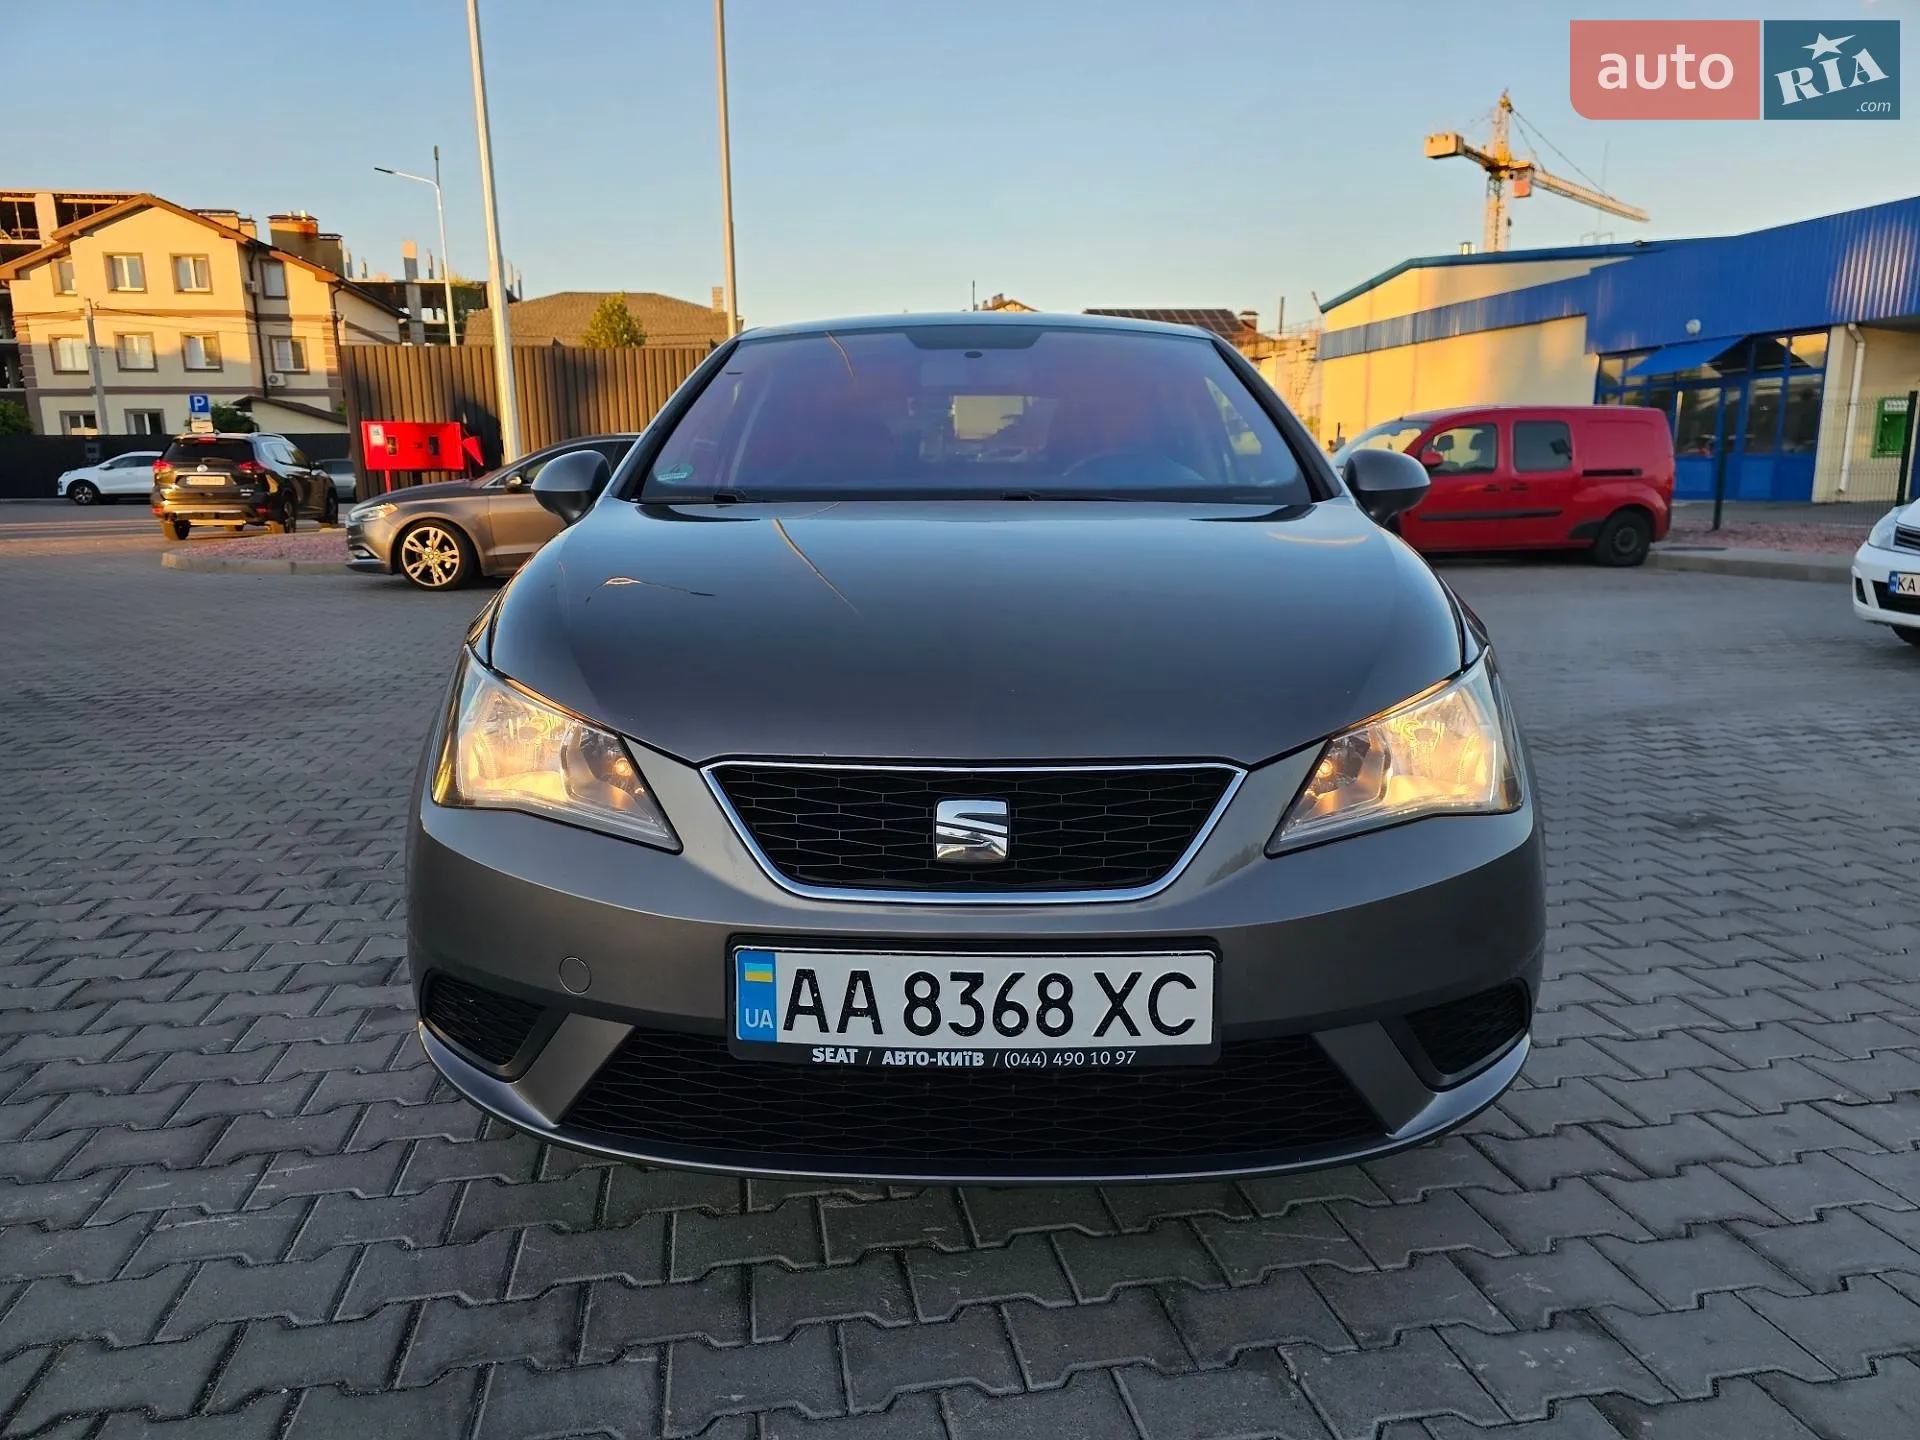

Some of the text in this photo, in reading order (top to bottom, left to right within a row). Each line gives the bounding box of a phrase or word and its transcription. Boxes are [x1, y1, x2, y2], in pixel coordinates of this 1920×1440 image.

[193, 396, 205, 411] P
[1897, 576, 1916, 592] KA
[783, 968, 1197, 1038] AA 8368 XC
[745, 1008, 774, 1029] UA
[812, 1047, 859, 1064] SEAT
[1003, 1051, 1048, 1068] (044)
[1052, 1051, 1085, 1066] 490
[1089, 1051, 1111, 1065] 10
[1114, 1050, 1137, 1065] 97
